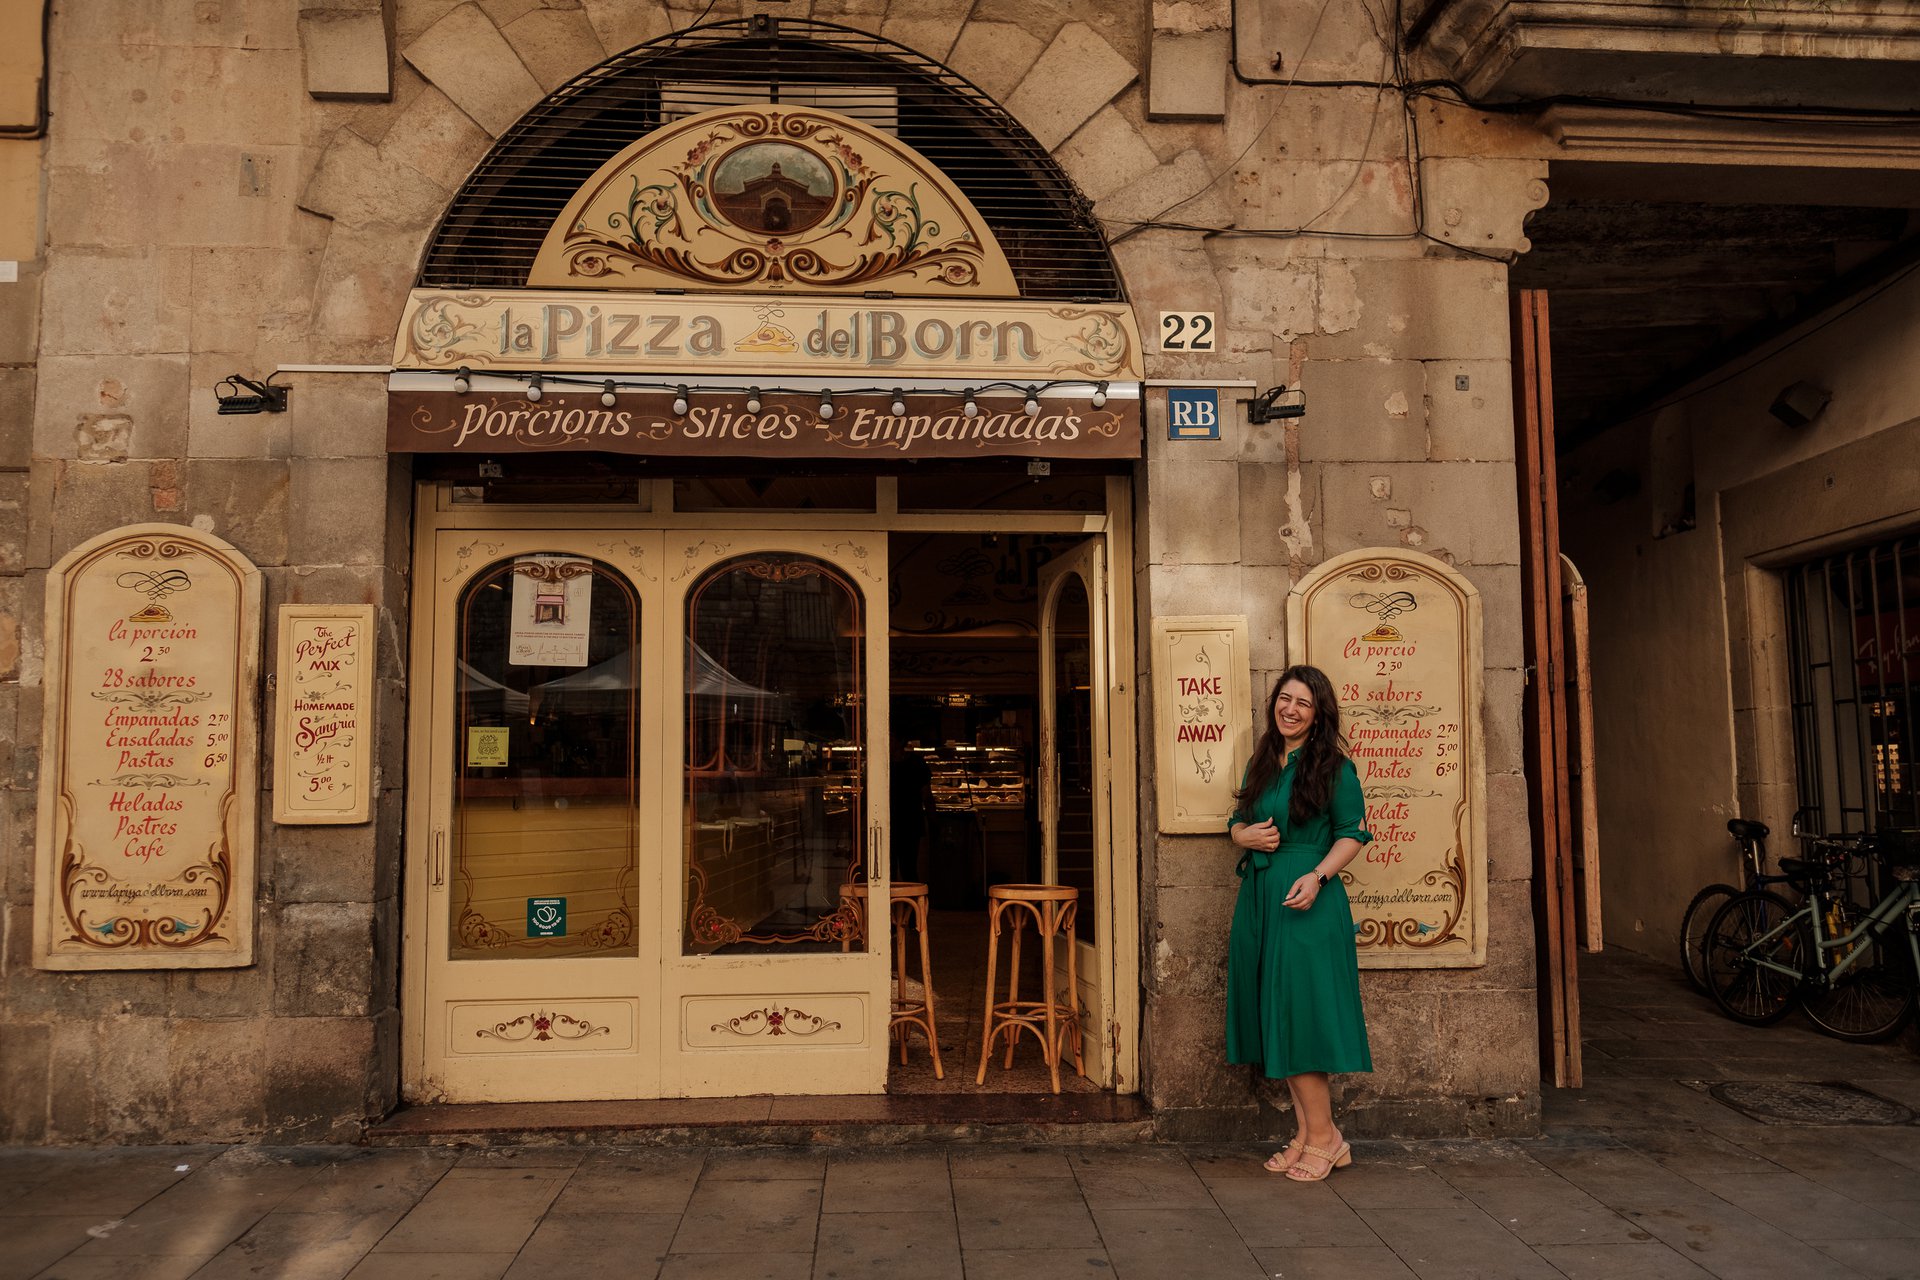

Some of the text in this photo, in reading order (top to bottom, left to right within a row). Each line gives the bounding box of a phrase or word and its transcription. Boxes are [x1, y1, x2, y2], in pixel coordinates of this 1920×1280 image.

[500, 304, 1041, 367] la Pizza del Born
[1163, 314, 1212, 349] 22
[454, 400, 632, 447] Porcions
[683, 404, 800, 440] Slices
[850, 406, 1082, 450] Empanadas
[1172, 401, 1216, 426] RB
[108, 620, 198, 648] la porción
[314, 626, 332, 638] The
[296, 632, 356, 664] Perfect
[1344, 637, 1360, 659] la
[309, 660, 340, 670] MIX
[102, 668, 196, 688] 28 sabores
[1177, 677, 1222, 696] TAKE
[1342, 680, 1423, 701] 28 sabors
[294, 699, 354, 711] HOMEMADE
[104, 706, 200, 732] Empanadas
[106, 728, 194, 747] Ensaladas
[296, 714, 356, 752] Sangria
[1177, 724, 1226, 743] AWAY
[1348, 720, 1432, 744] Empanades
[1348, 740, 1423, 758] Amanides
[116, 750, 174, 774] Pastas
[1362, 760, 1412, 785] Pastes
[108, 792, 183, 812] Helados
[113, 816, 178, 841] Postres
[124, 837, 169, 864] Cafe
[1366, 844, 1405, 869] Cafe
